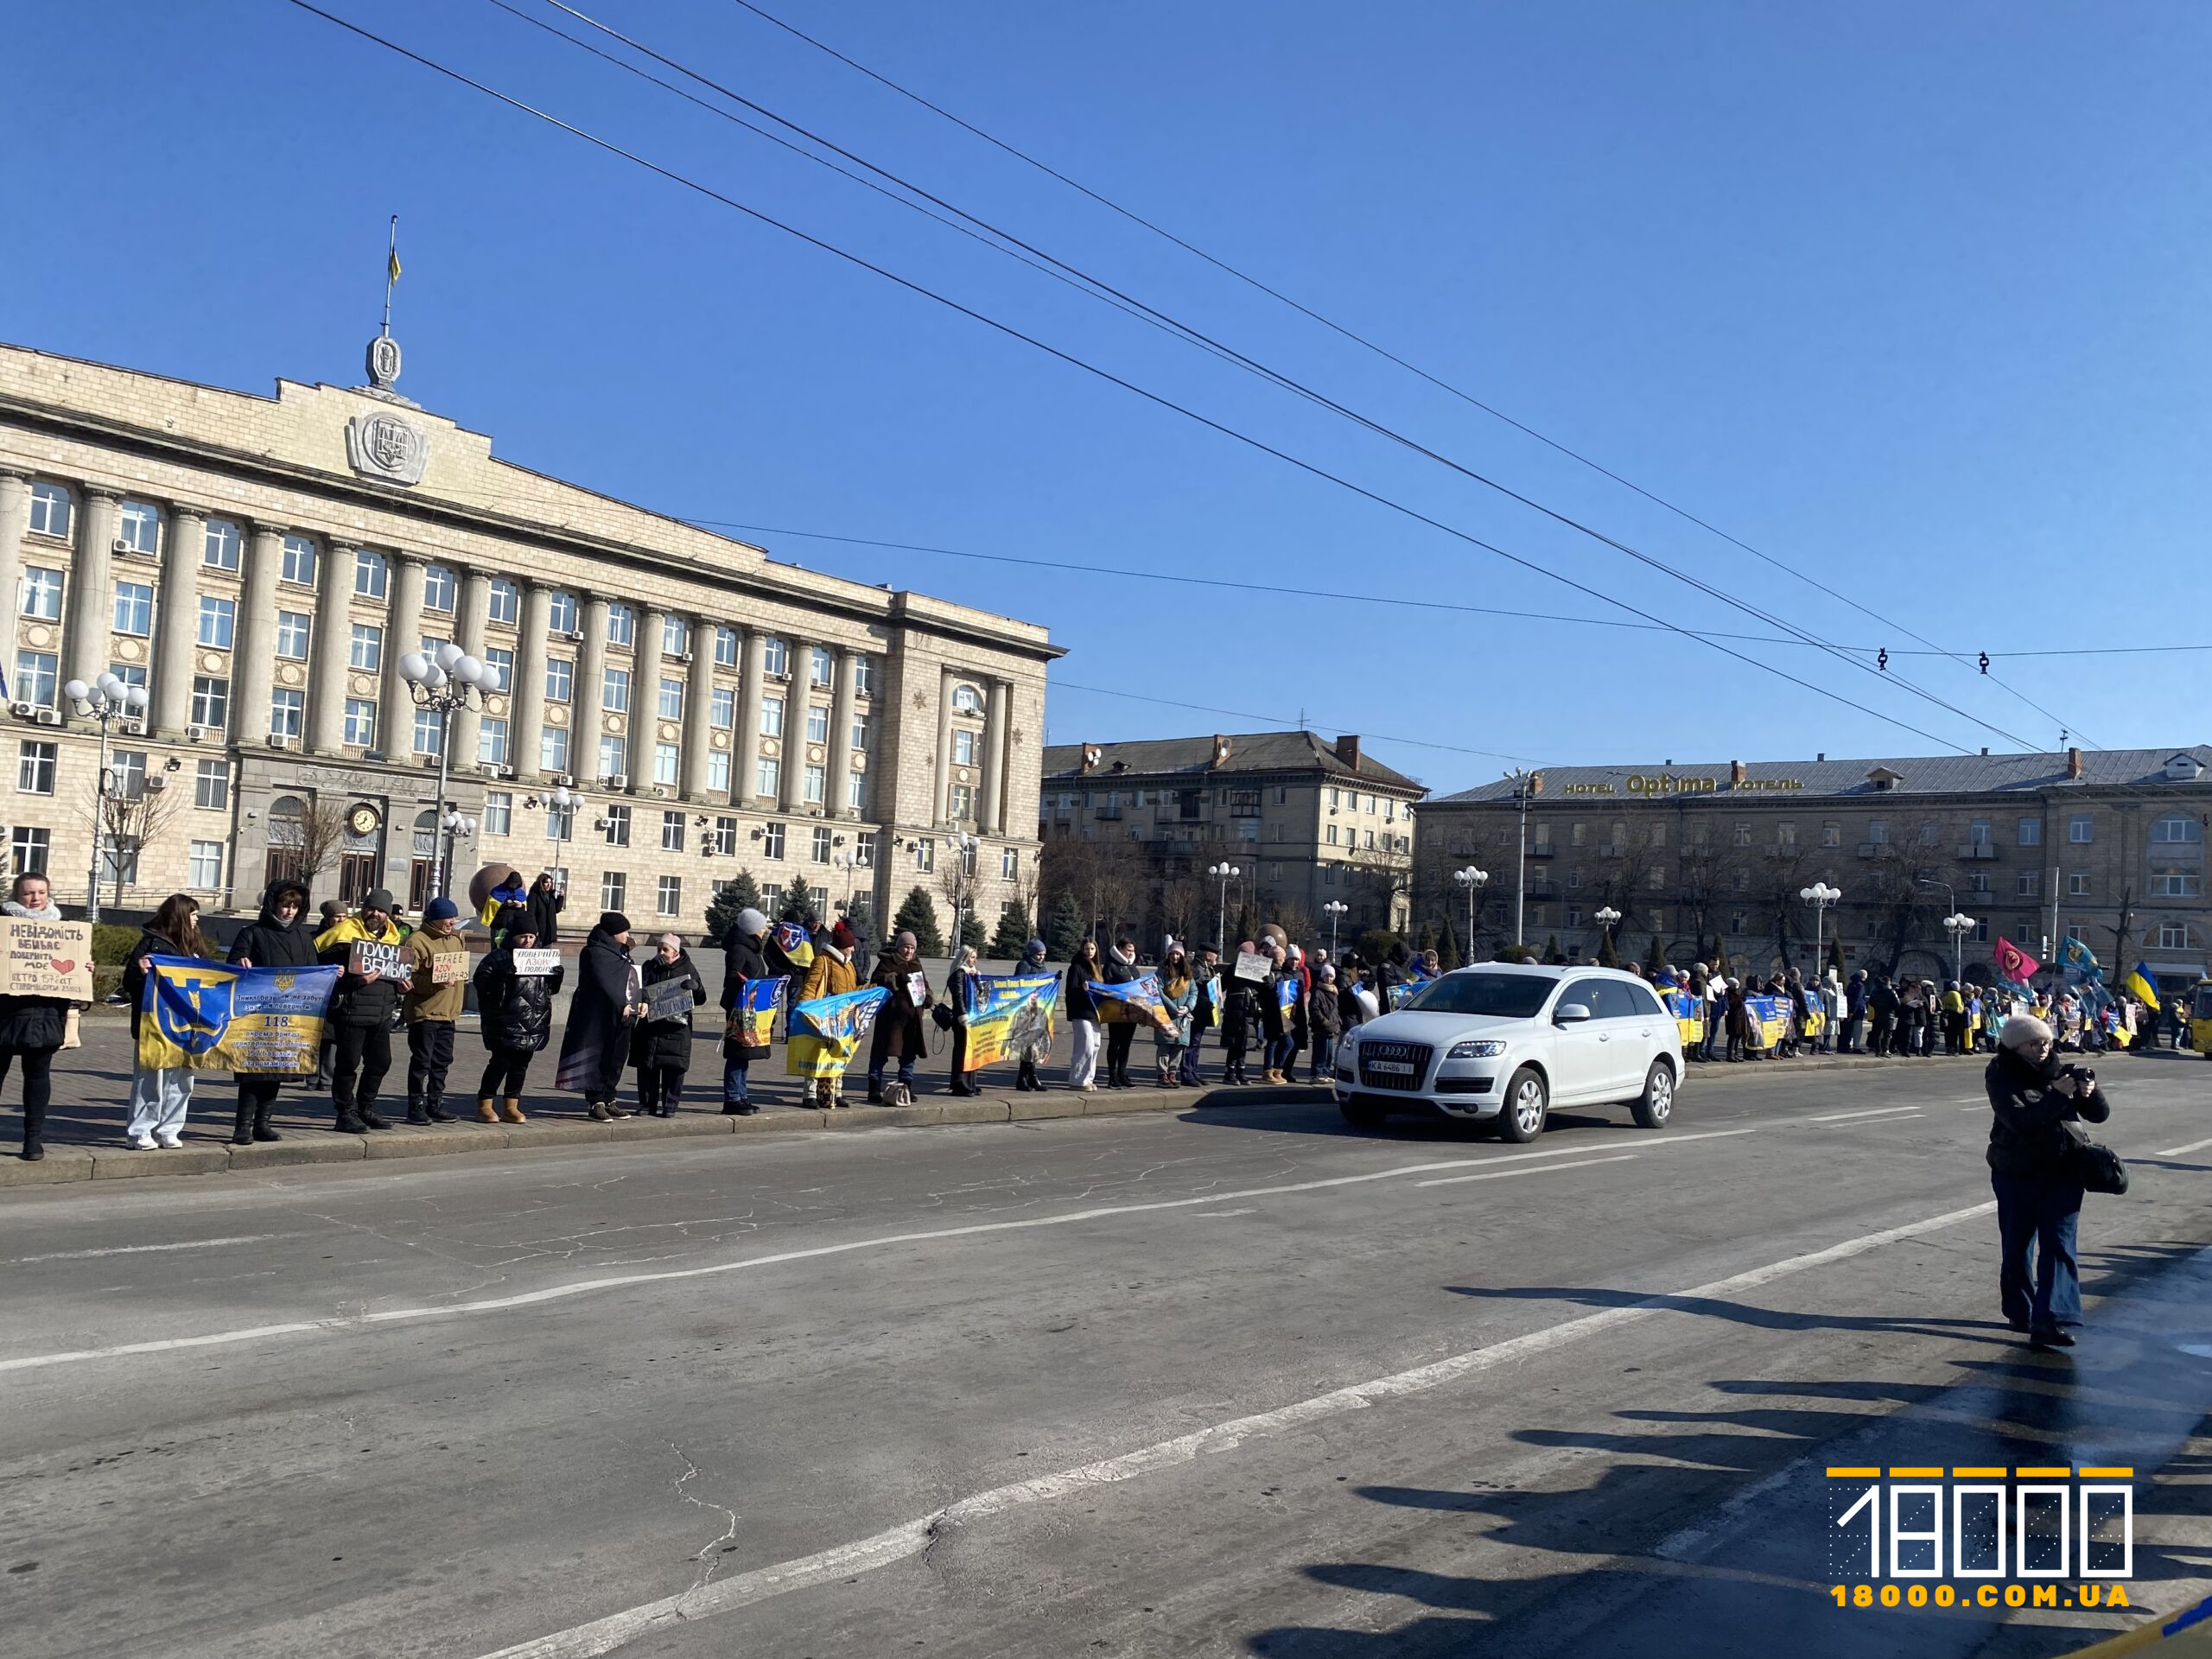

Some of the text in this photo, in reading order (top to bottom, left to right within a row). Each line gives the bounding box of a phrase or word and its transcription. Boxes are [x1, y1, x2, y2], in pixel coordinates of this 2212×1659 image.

[1564, 771, 1805, 798] HOTEL Optima ГОТЕЛЬ
[10, 922, 84, 940] НЕВІДОМІСТЬ
[18, 938, 60, 950] ВБИВАЄ
[10, 950, 53, 960] ПОВЕРНІТЬ
[356, 941, 401, 963] ПОЛОН
[435, 953, 462, 963] #FREE
[362, 957, 412, 980] ВБИВАЄ
[434, 964, 450, 973] AZOV
[264, 1015, 289, 1027] 118
